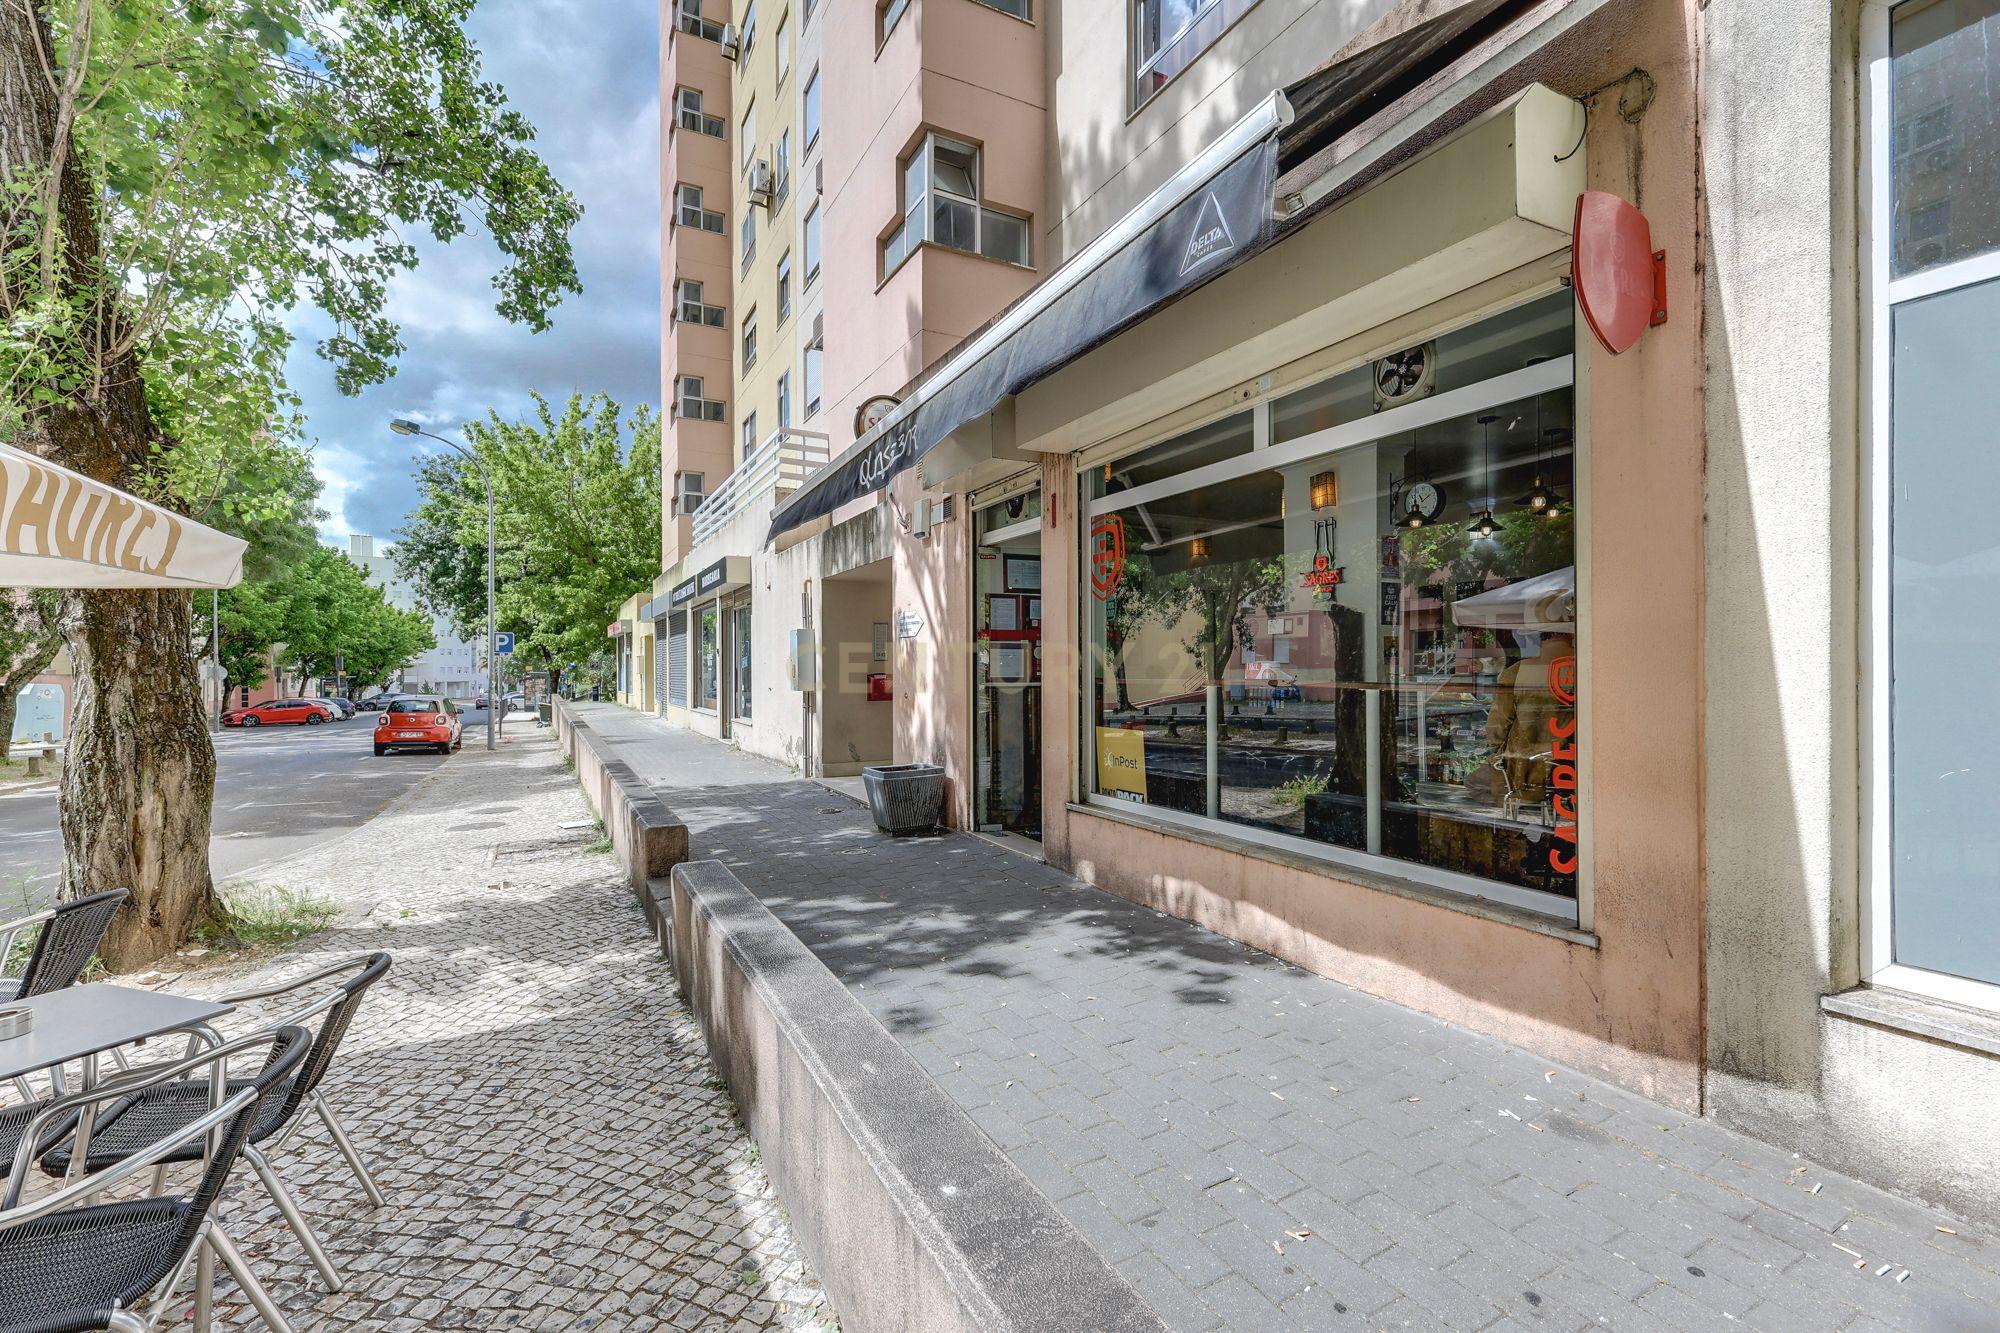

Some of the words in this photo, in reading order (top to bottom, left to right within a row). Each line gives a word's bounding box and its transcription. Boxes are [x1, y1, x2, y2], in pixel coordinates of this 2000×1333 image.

[1190, 226, 1224, 255] DELTA
[1303, 569, 1340, 587] SAGRES
[495, 634, 509, 652] P
[1112, 755, 1138, 769] InPost
